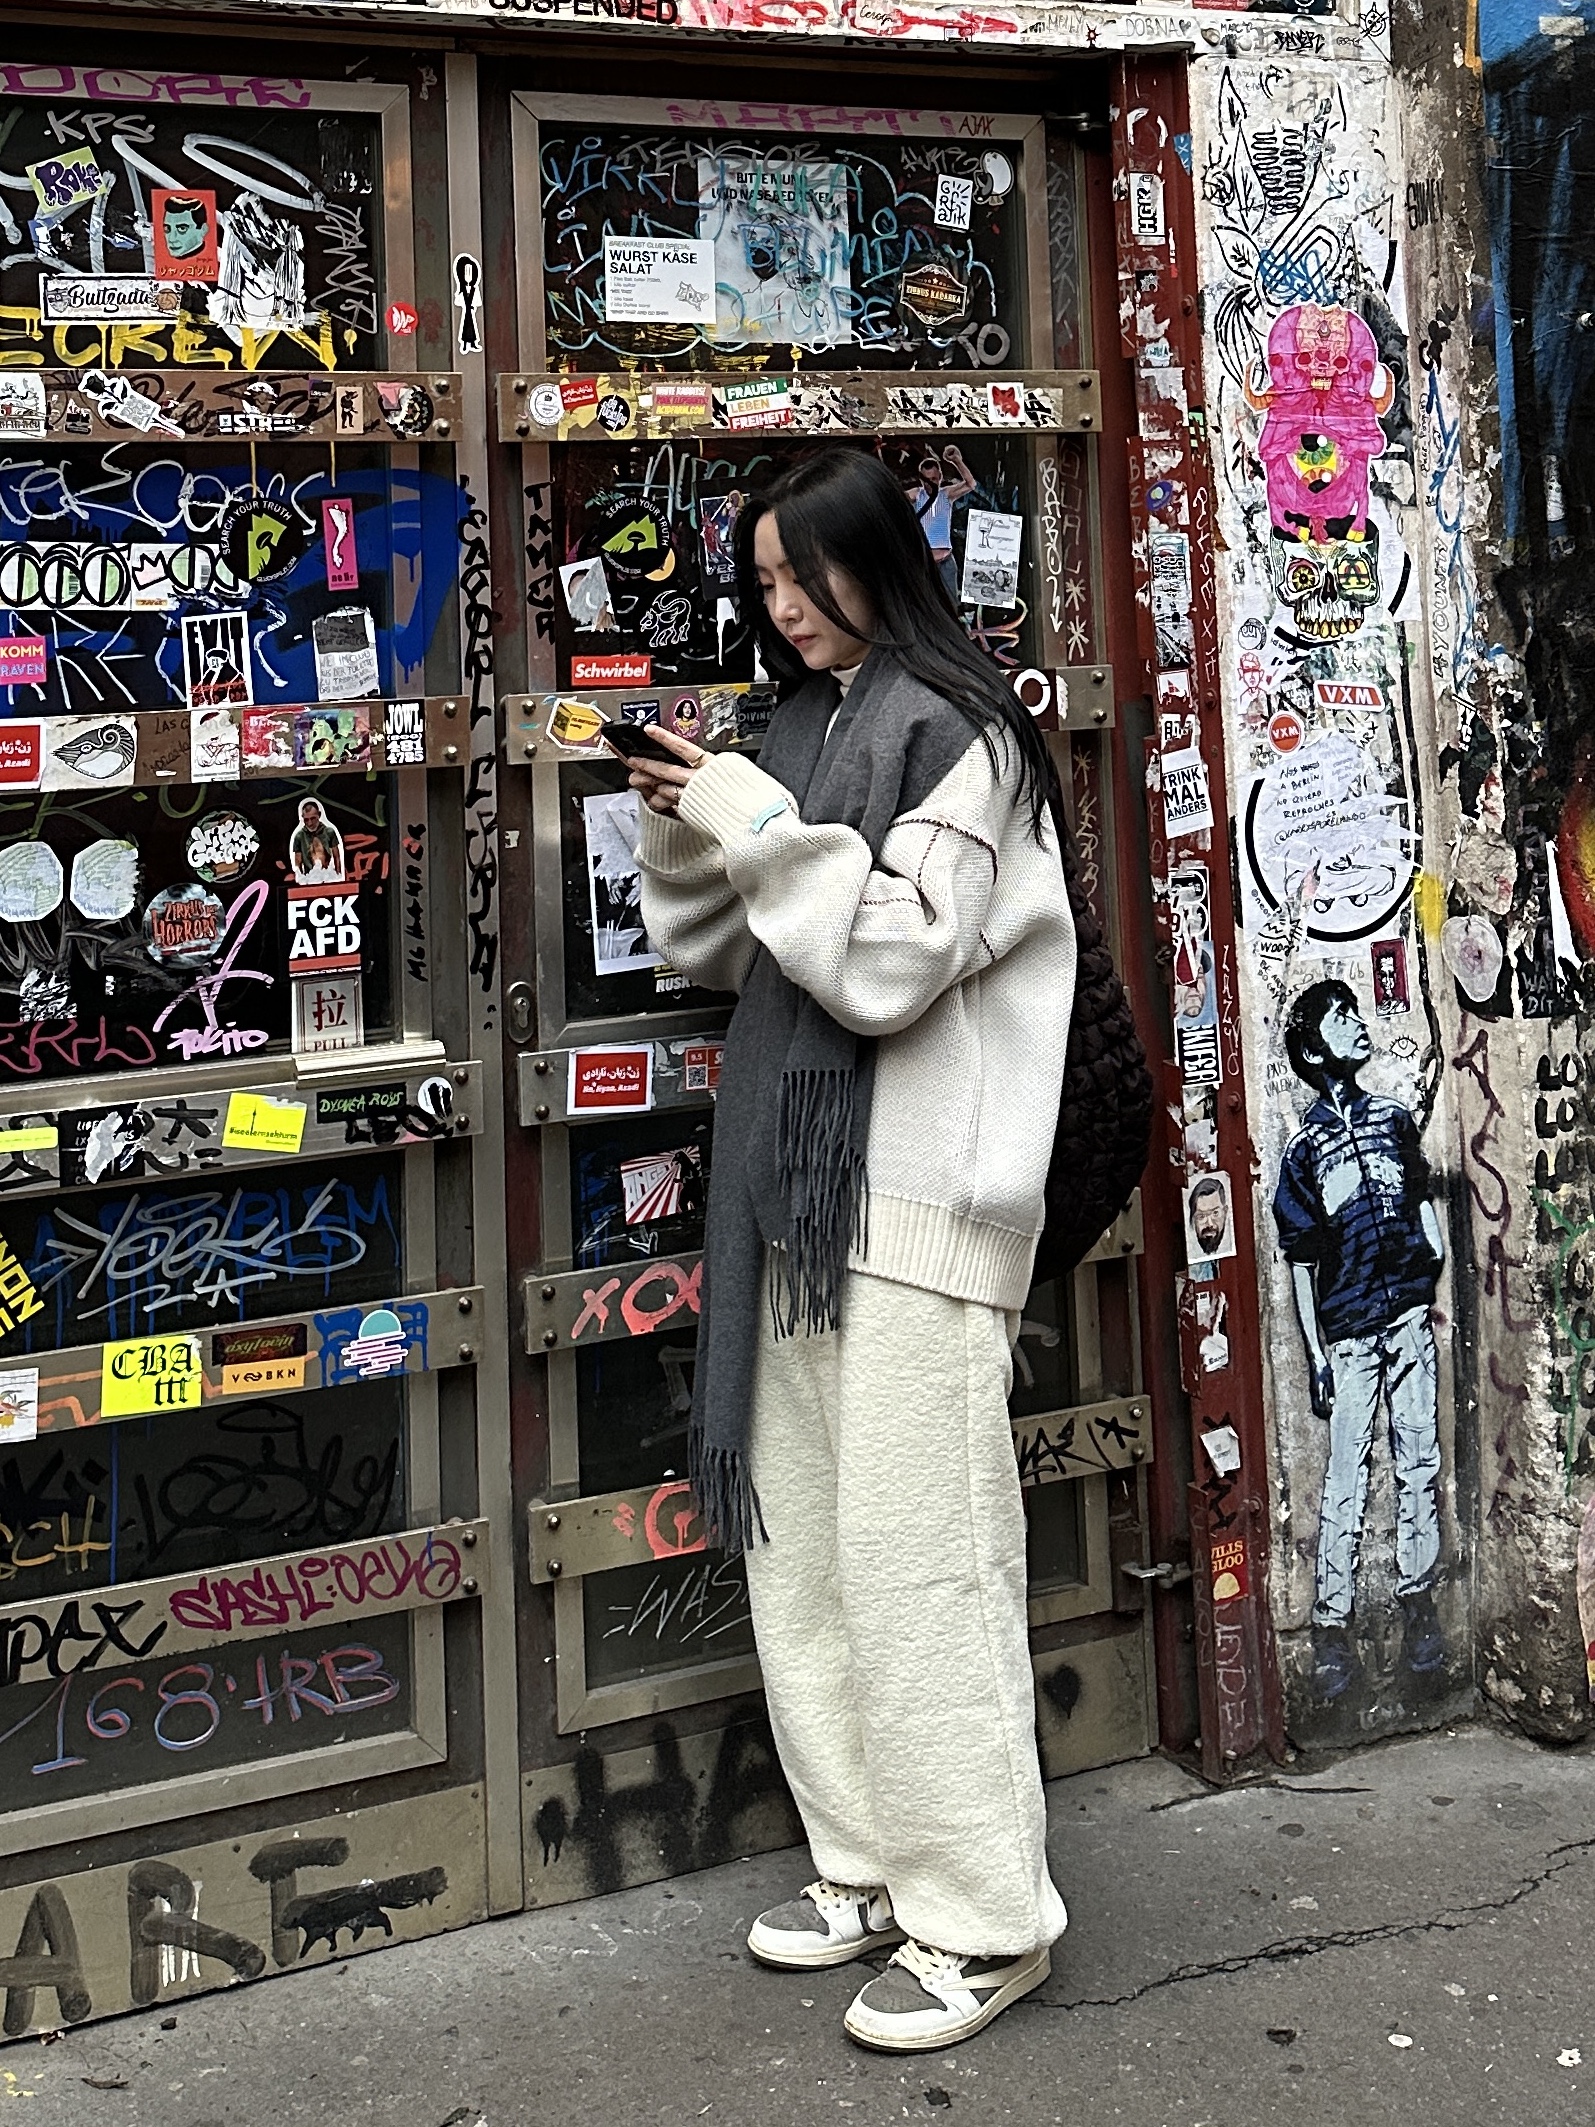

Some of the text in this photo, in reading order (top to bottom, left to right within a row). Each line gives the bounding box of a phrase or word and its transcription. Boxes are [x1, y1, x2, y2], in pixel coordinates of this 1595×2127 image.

[609, 249, 698, 264] WURST KÄSE
[609, 262, 654, 275] SALAT
[726, 382, 779, 399] FRAUEN
[729, 398, 770, 415] LEBEN
[220, 500, 292, 555] SEARCH YOUR TRUTH
[605, 497, 670, 547] SEARCH YOUR TRUTH
[575, 662, 649, 680] Schwirbel
[1323, 685, 1374, 706] VXM
[1271, 725, 1300, 740] VXM
[1162, 766, 1202, 789] TRINK
[1163, 781, 1205, 809] MAL
[1167, 799, 1207, 821] ANDERS
[288, 894, 361, 930] FCK
[151, 908, 218, 948] HORRORS
[289, 924, 362, 960] AFD
[312, 988, 348, 1032] 拉
[111, 1343, 194, 1383] CBA
